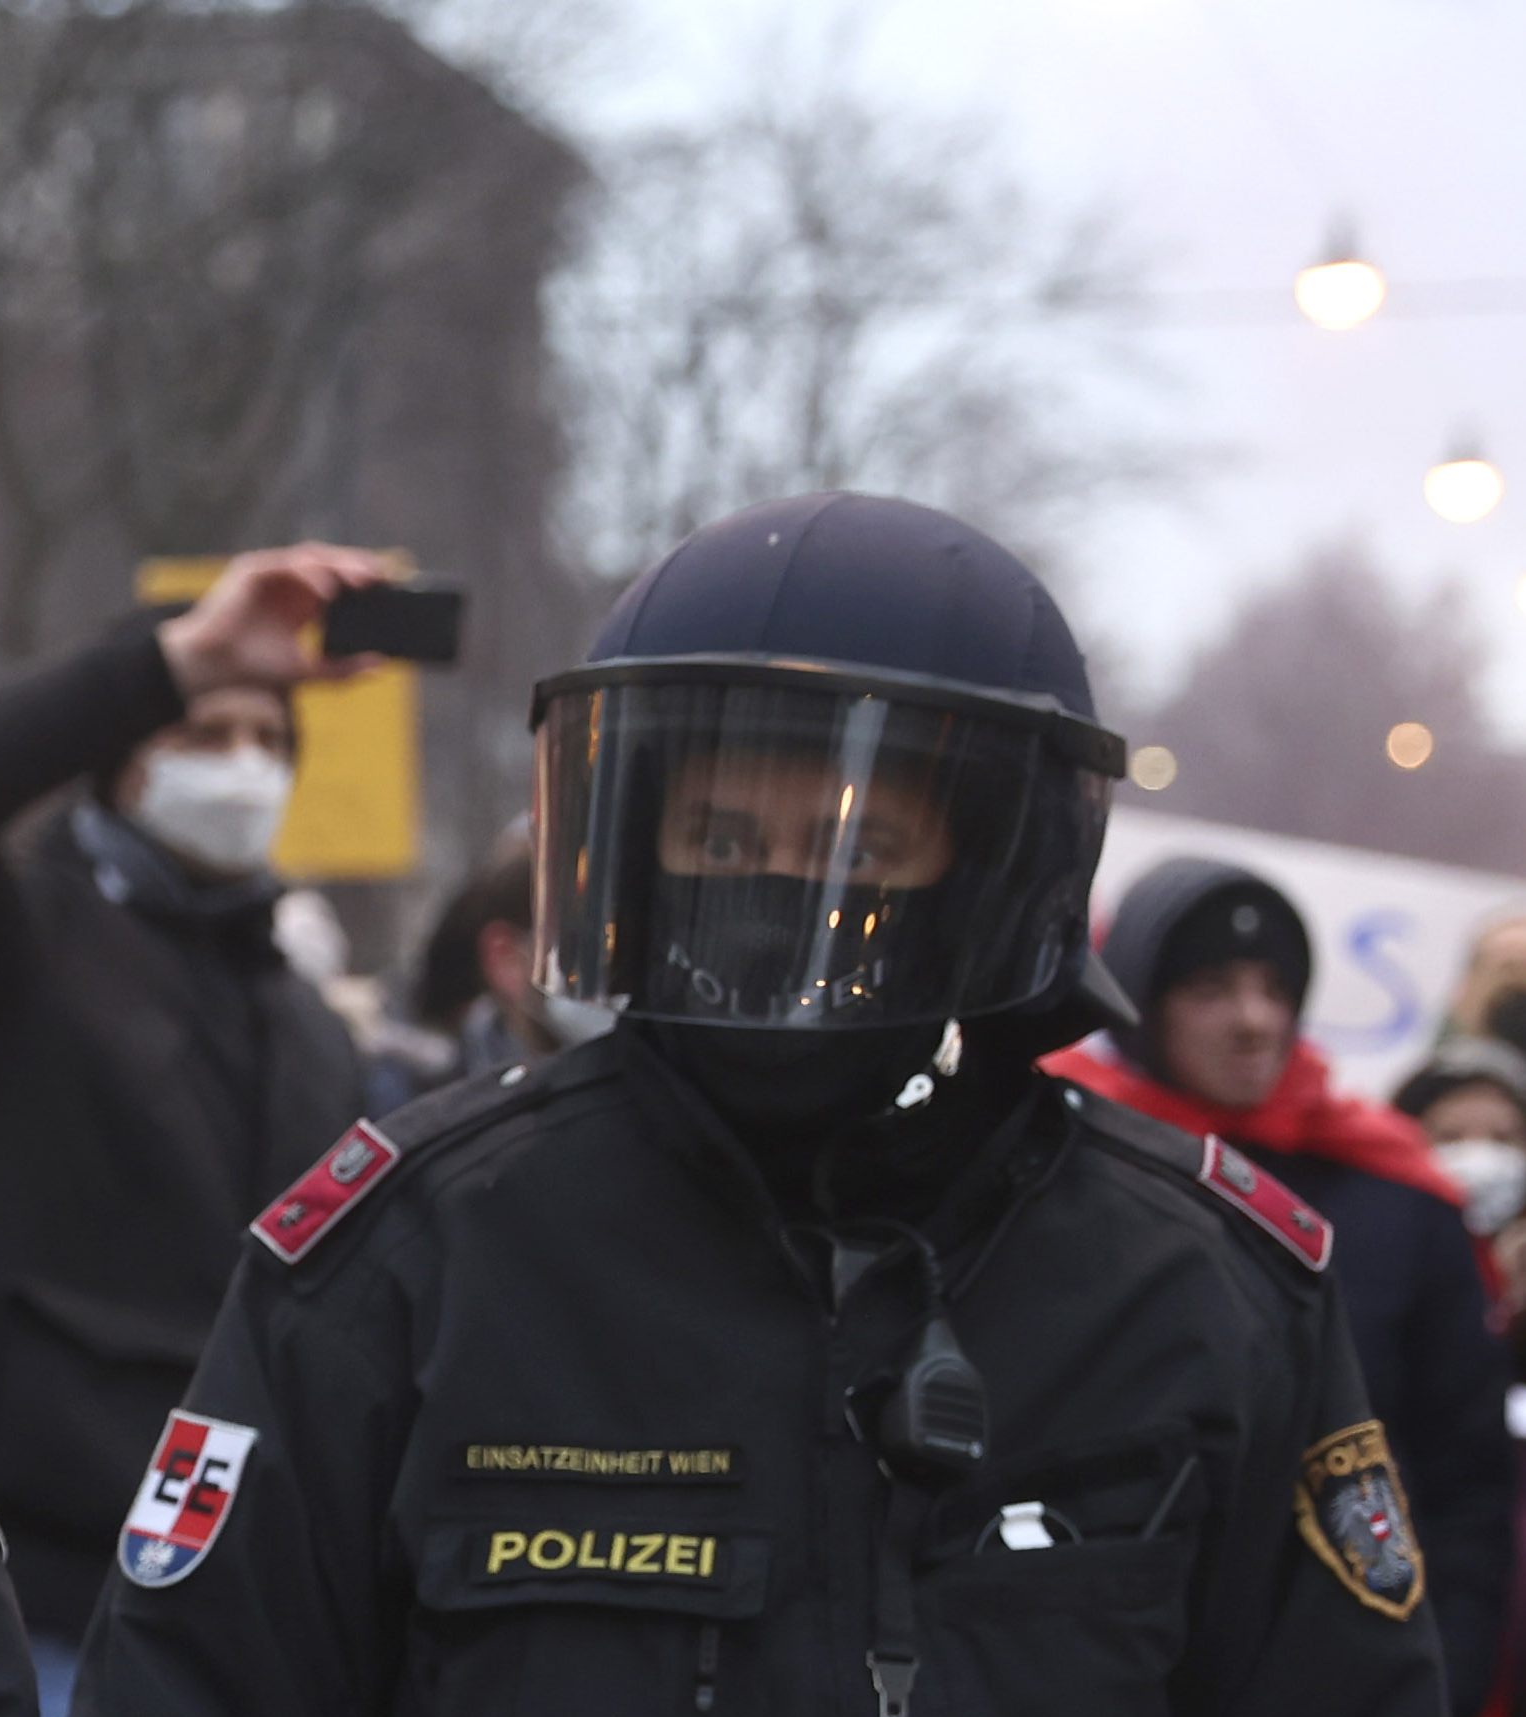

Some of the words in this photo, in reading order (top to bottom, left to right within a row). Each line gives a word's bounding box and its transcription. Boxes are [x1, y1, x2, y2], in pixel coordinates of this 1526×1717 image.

[154, 1448, 230, 1515] EE
[465, 1444, 665, 1476] EINSATZEINHEIT
[668, 1448, 732, 1476] WIEN
[486, 1528, 717, 1579] POLIZEI
